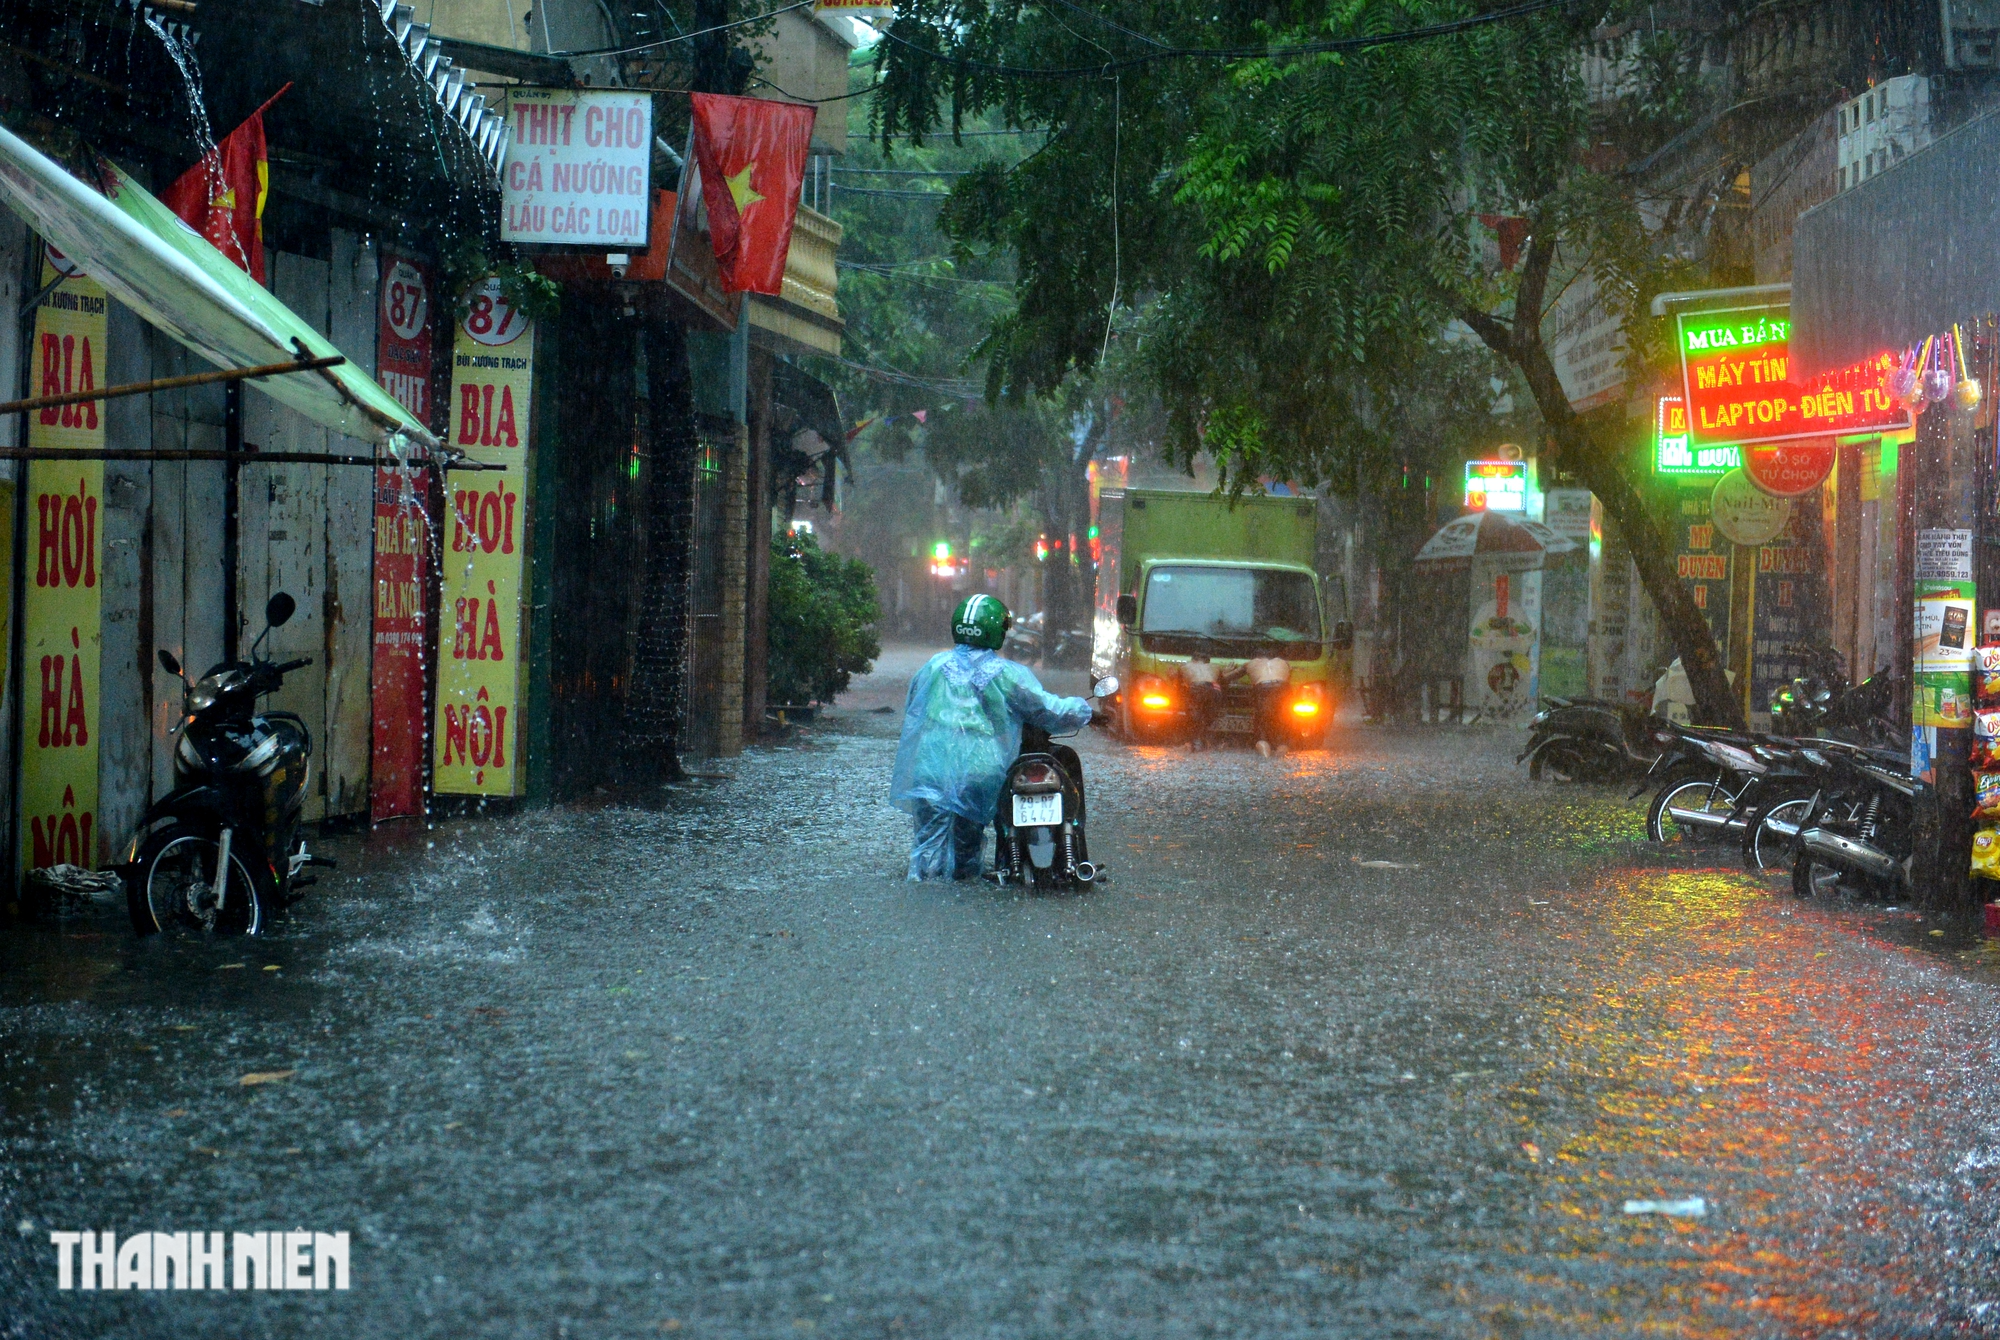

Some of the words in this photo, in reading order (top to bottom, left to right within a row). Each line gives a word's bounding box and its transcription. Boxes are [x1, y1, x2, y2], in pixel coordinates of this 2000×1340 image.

[513, 103, 576, 155] THỊT
[585, 98, 645, 149] CHÓ
[509, 156, 544, 191] CÁ
[552, 158, 643, 196] NƯỚNG
[508, 194, 546, 233] LẨU
[551, 201, 591, 234] CÁC
[596, 207, 641, 243] LOẠI
[80, 294, 105, 317] TRẠCH
[390, 281, 422, 330] 87
[468, 294, 518, 336] 87
[1687, 328, 1739, 351] MUA
[1740, 317, 1786, 345] BÁN
[40, 332, 99, 430] BIA
[456, 355, 470, 368] BÙI
[501, 356, 528, 371] TRẠCH
[1696, 356, 1746, 391] MÁY
[1749, 351, 1789, 384] TÍN
[458, 383, 519, 447] BIA
[36, 477, 98, 588] HƠI
[376, 515, 400, 554] BIA
[402, 513, 425, 555] HƠI
[452, 479, 517, 555] HƠI
[1678, 551, 1727, 580] DUYÊN
[453, 579, 504, 662] HÀ
[955, 624, 982, 637] Grab
[38, 626, 88, 748] HÀ
[443, 685, 507, 786] NỘI
[1020, 809, 1055, 824] 6447
